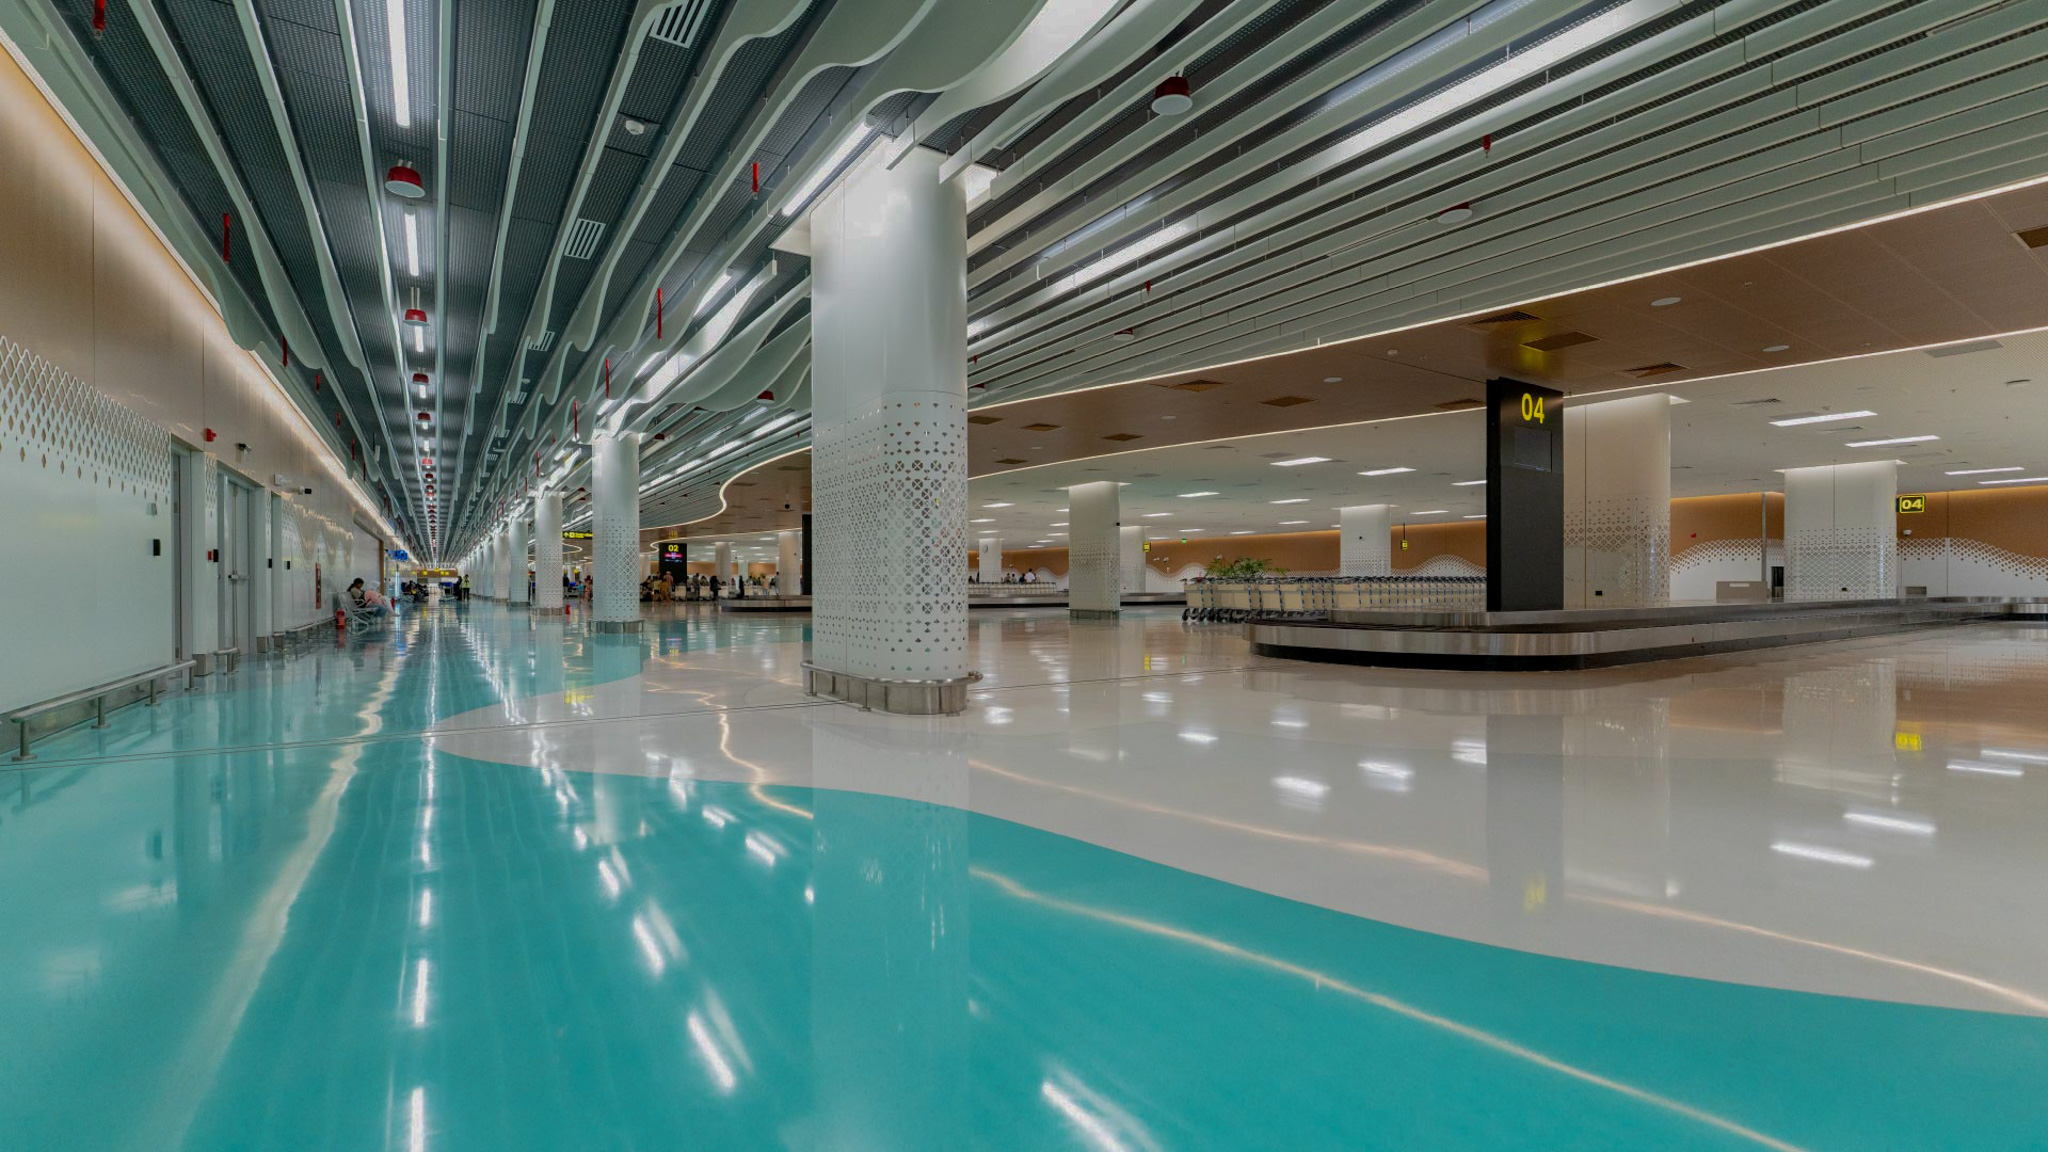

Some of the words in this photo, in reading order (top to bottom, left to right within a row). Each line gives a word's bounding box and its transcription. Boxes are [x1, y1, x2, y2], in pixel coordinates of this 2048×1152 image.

[1521, 392, 1545, 424] 04
[1902, 499, 1922, 509] 04
[668, 544, 679, 552] 02
